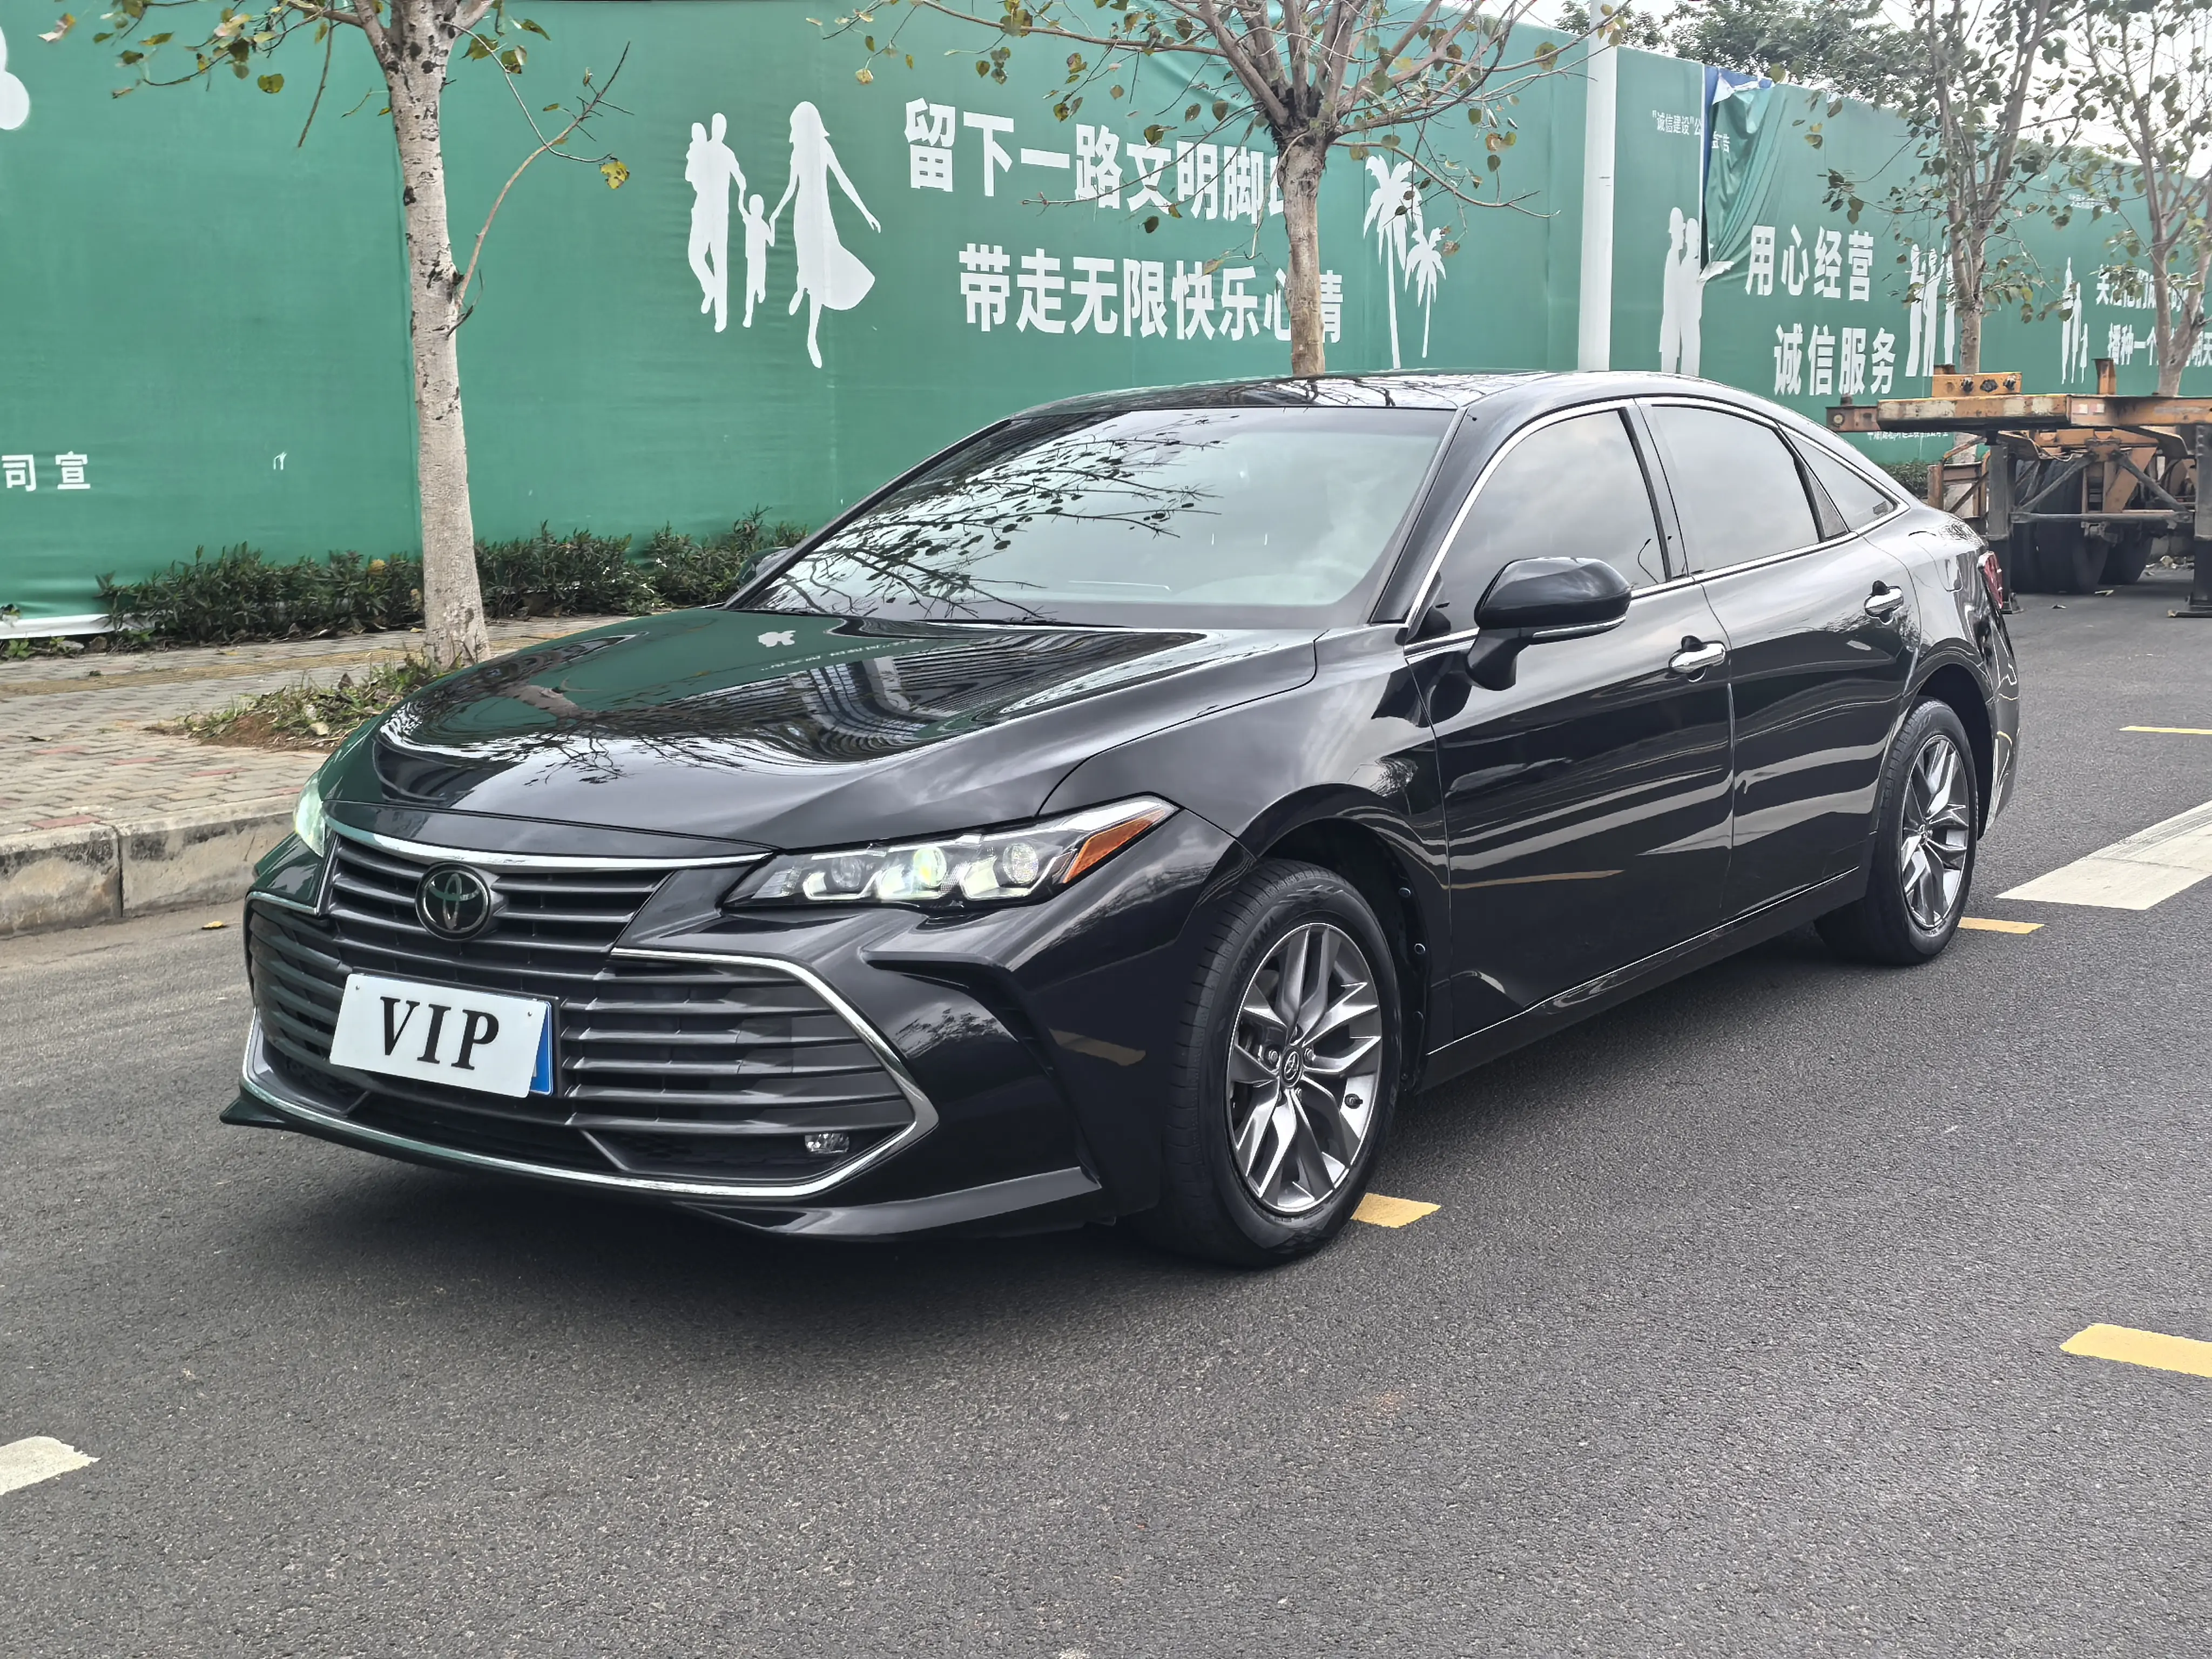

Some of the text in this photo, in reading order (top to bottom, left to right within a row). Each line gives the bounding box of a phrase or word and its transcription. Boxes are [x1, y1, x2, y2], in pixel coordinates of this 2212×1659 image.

[959, 244, 1343, 343] 带走无限快乐心情
[1745, 224, 1873, 301] 用心经营
[1773, 323, 1896, 395] 诚信服务
[380, 996, 499, 1070] VIP
